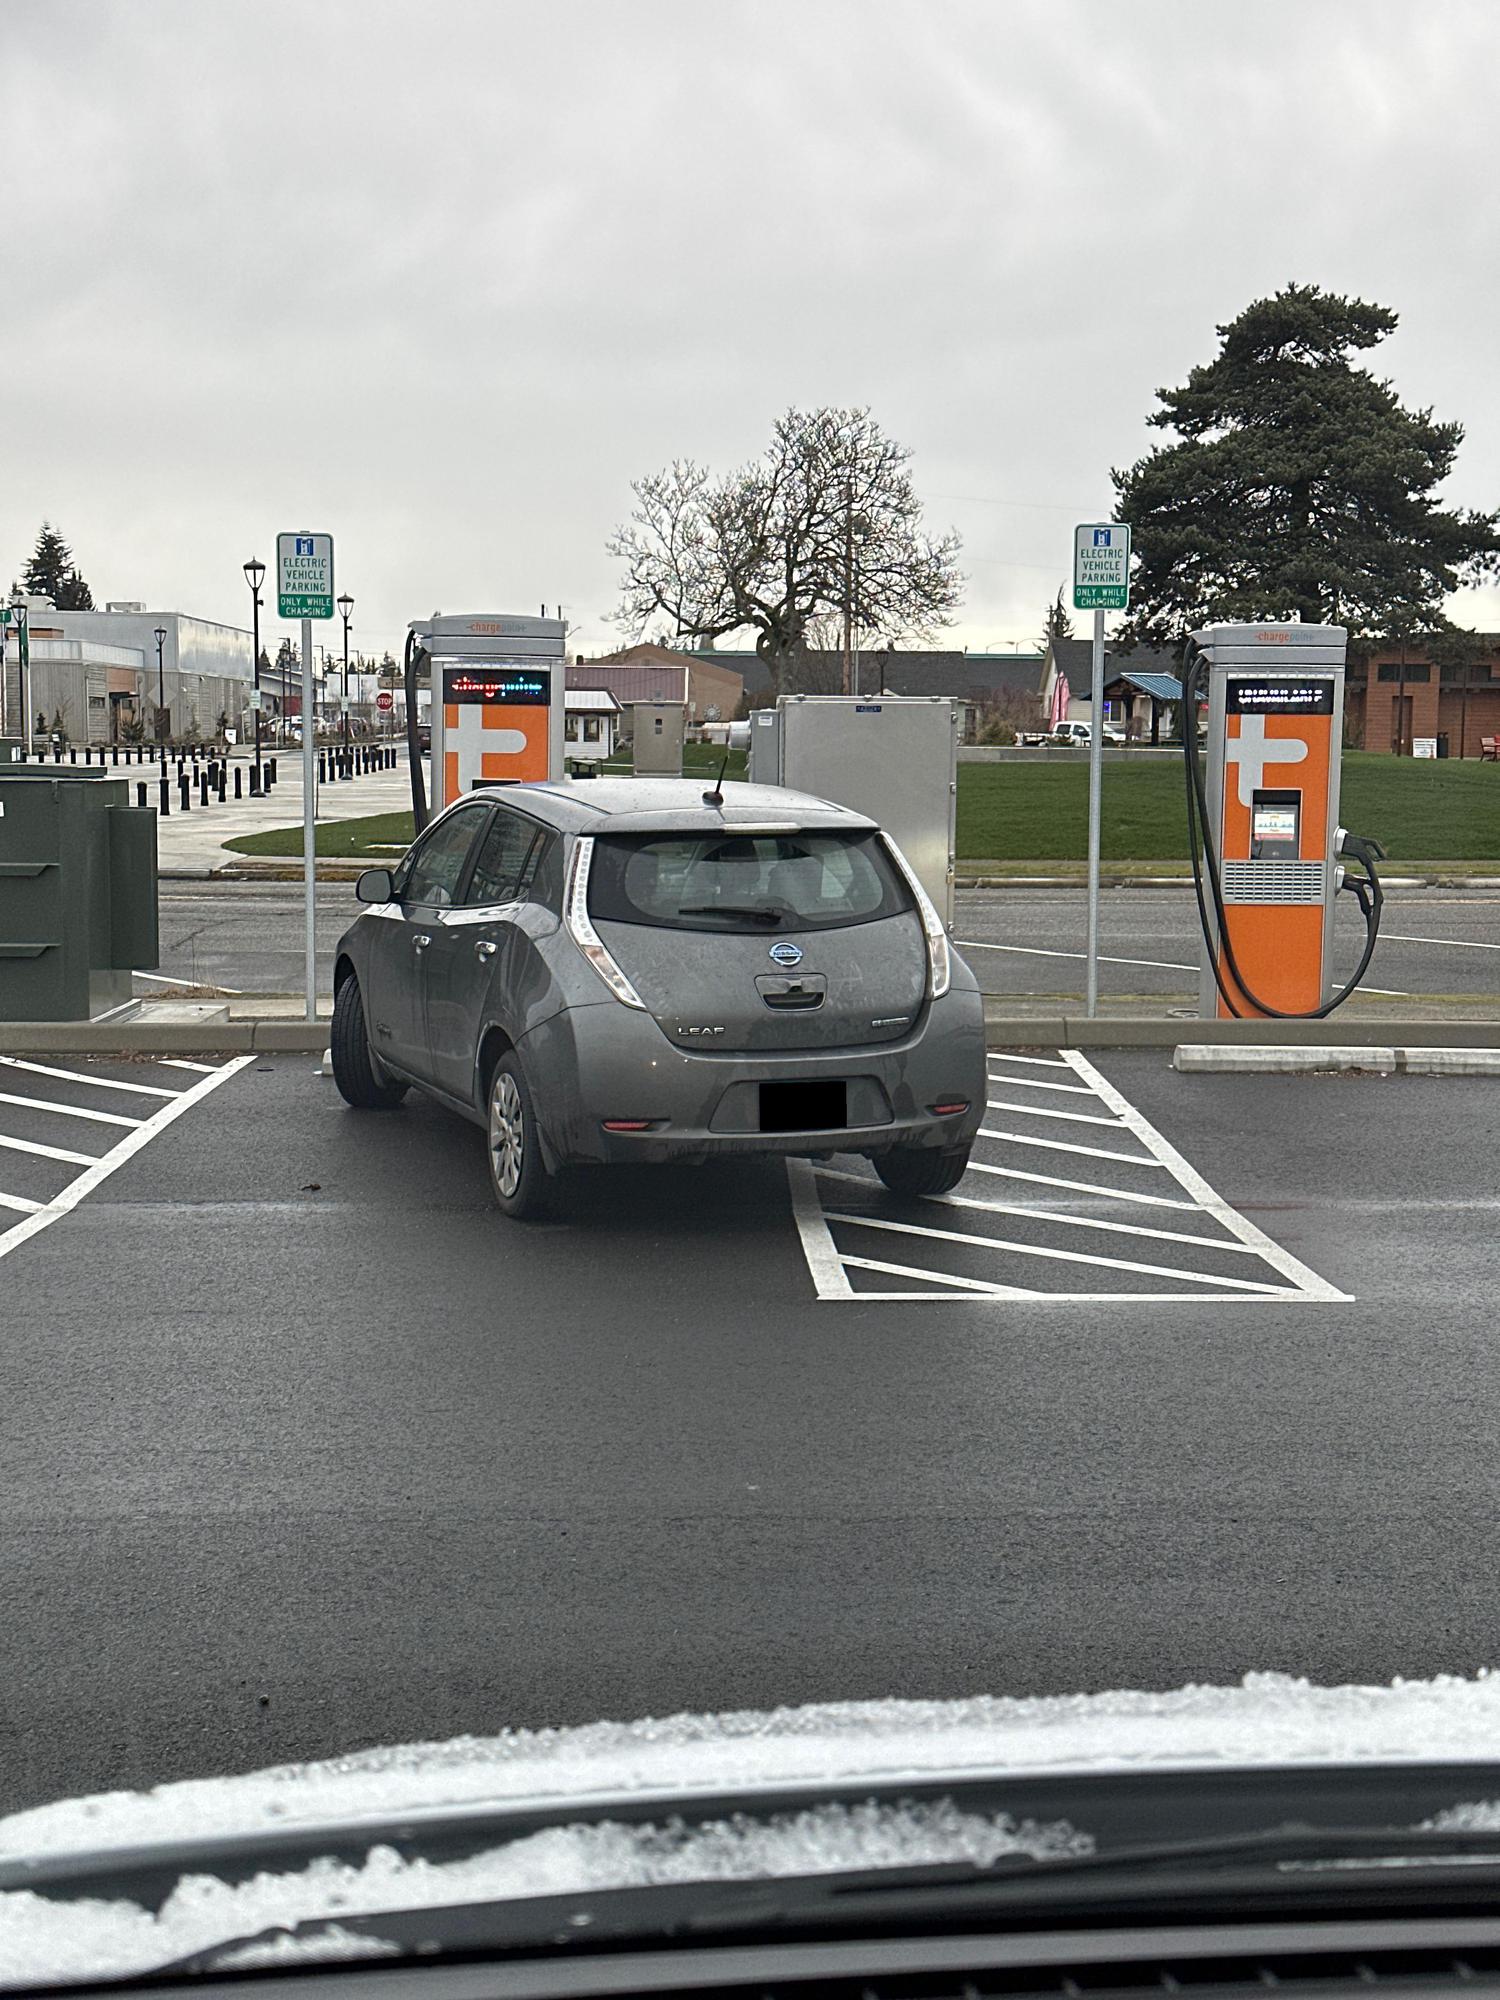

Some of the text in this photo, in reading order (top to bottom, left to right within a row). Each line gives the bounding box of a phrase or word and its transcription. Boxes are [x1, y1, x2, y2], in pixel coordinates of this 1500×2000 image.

[1080, 549, 1123, 559] ELECTRIC
[283, 557, 327, 568] ELECTRIC
[1083, 561, 1120, 571] VEHICLE
[286, 569, 325, 580] VEHICLE
[1081, 573, 1121, 583] PARKING
[285, 582, 326, 593] PARKING
[1076, 588, 1126, 597] ONLY WHILE
[280, 597, 331, 607] ONLY WHILE
[377, 697, 392, 706] STOP
[678, 1027, 725, 1036] LEAF
